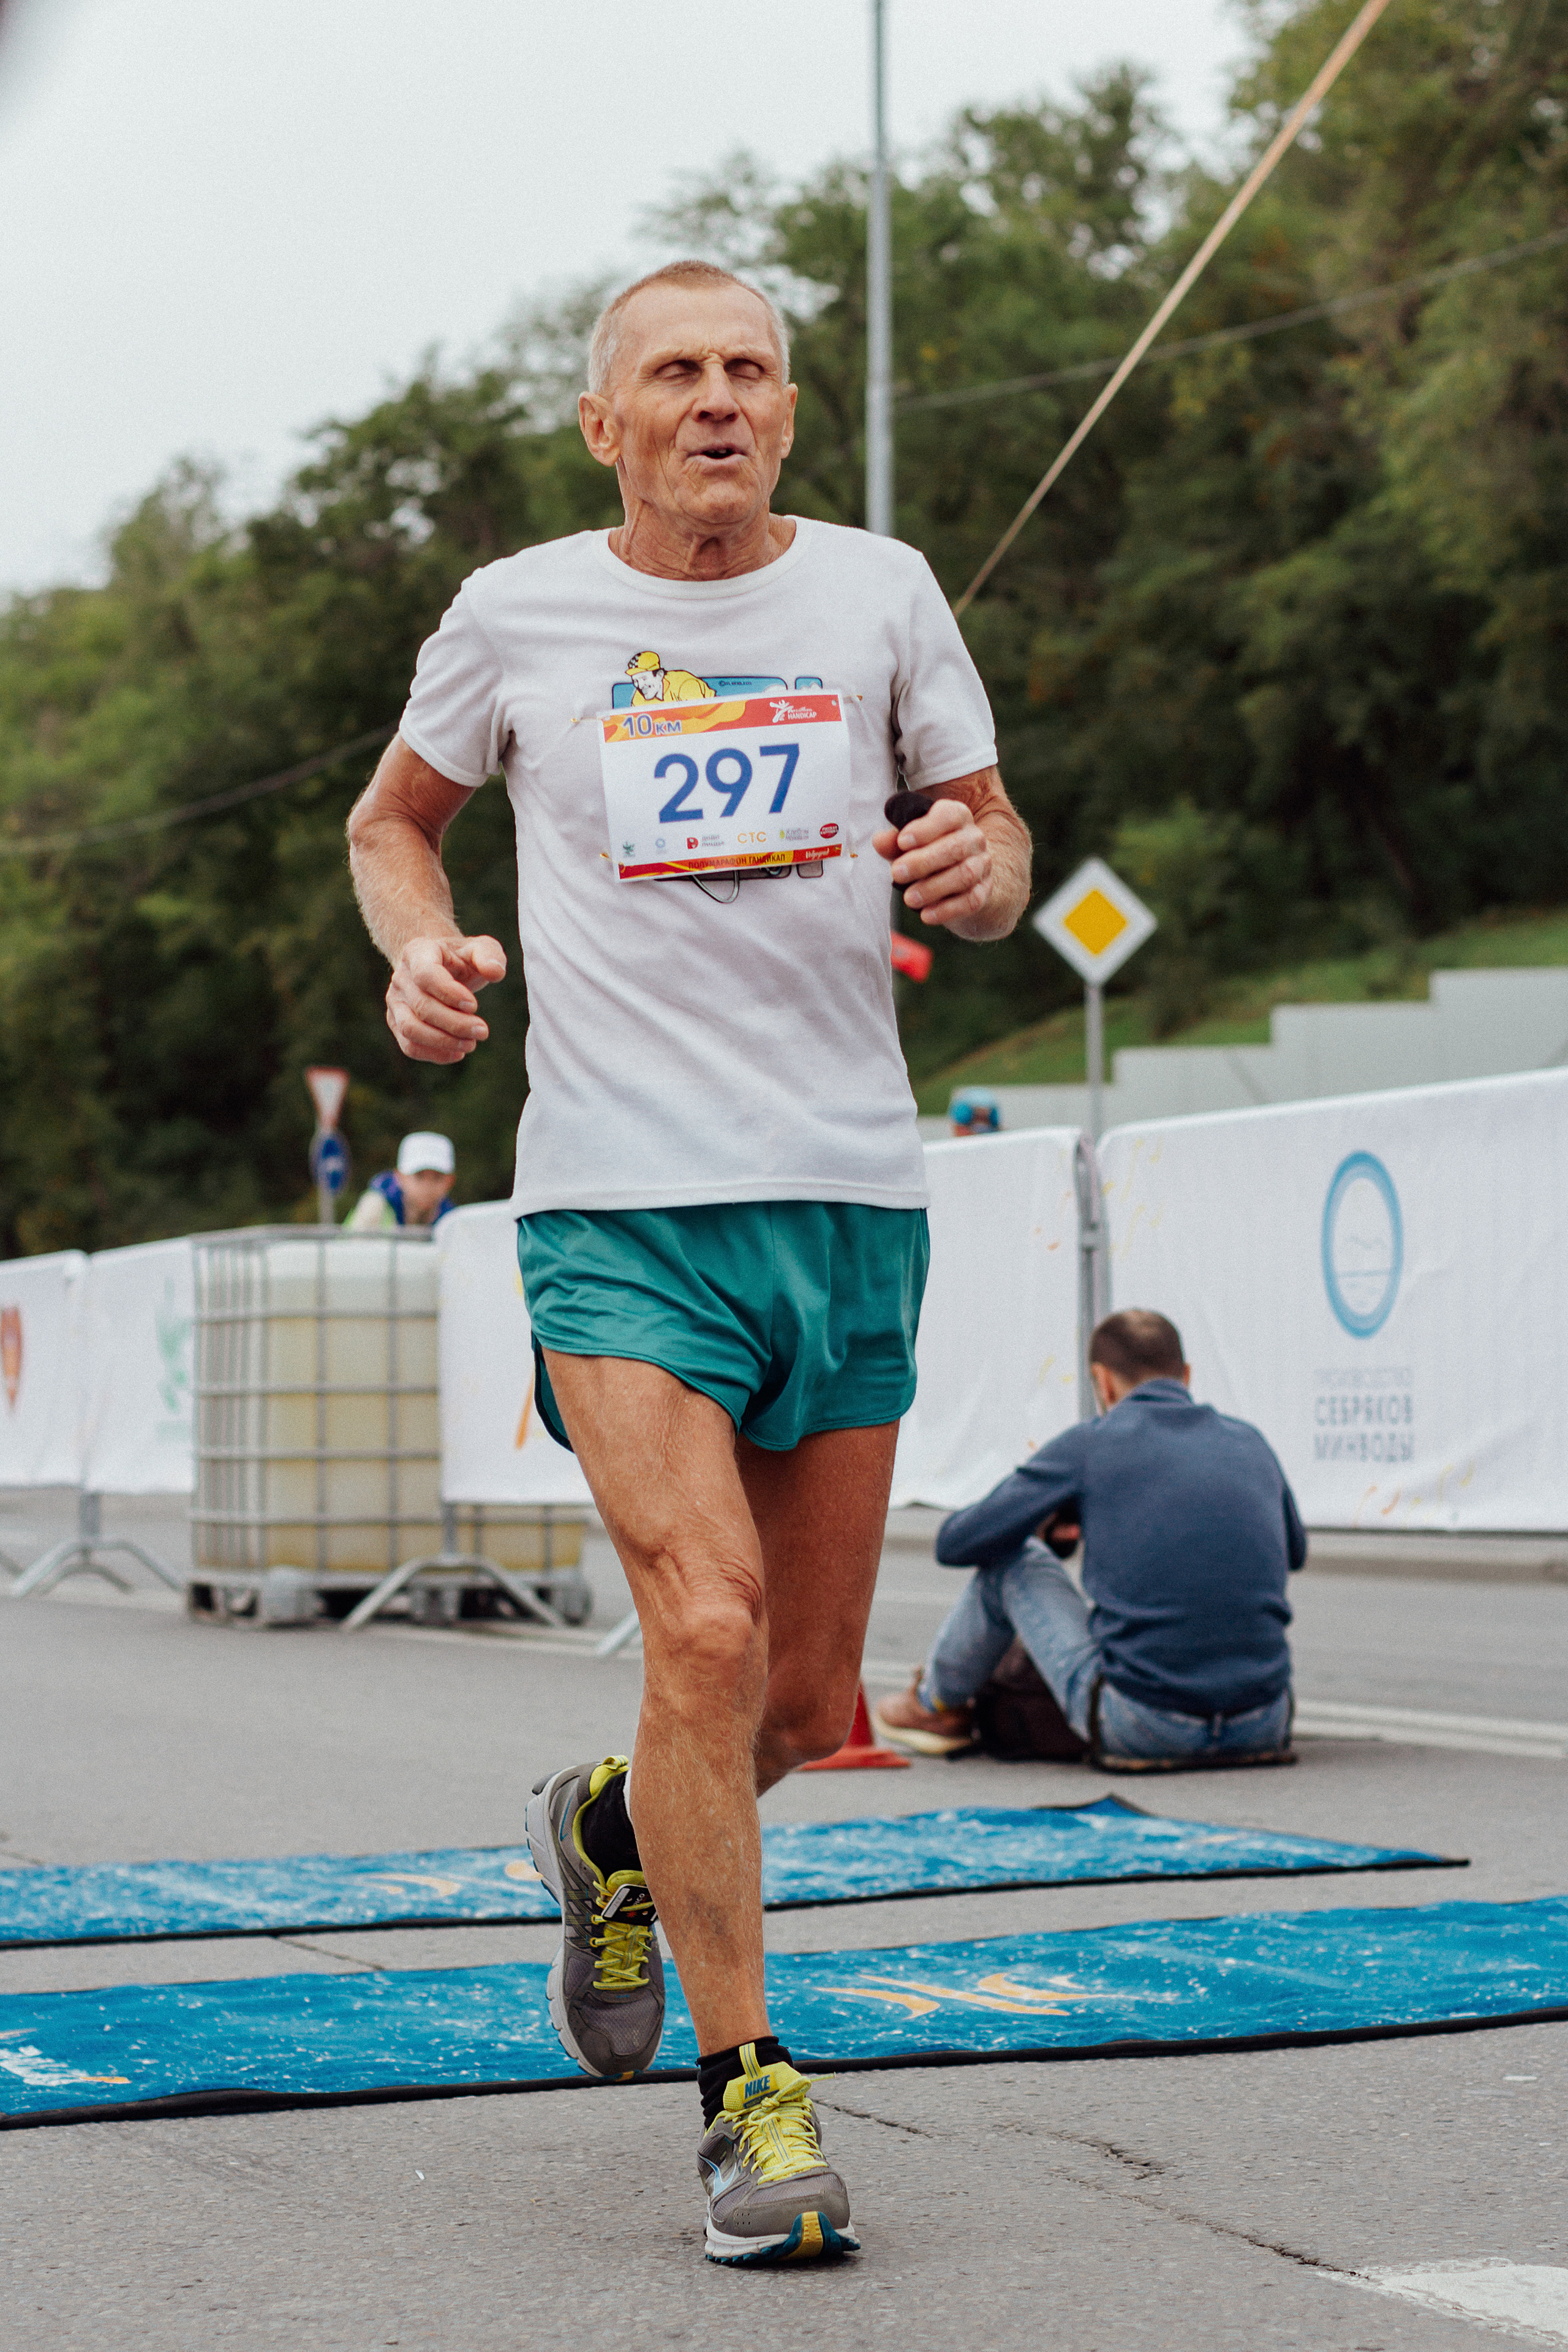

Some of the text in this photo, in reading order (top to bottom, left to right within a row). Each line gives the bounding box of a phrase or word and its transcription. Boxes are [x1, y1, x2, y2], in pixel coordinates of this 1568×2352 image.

[622, 714, 653, 737] 10
[654, 743, 799, 823] 297
[688, 854, 785, 869] ПОЛУМАРАФОН ГАНДИКАП
[745, 2075, 771, 2100] NIKE
